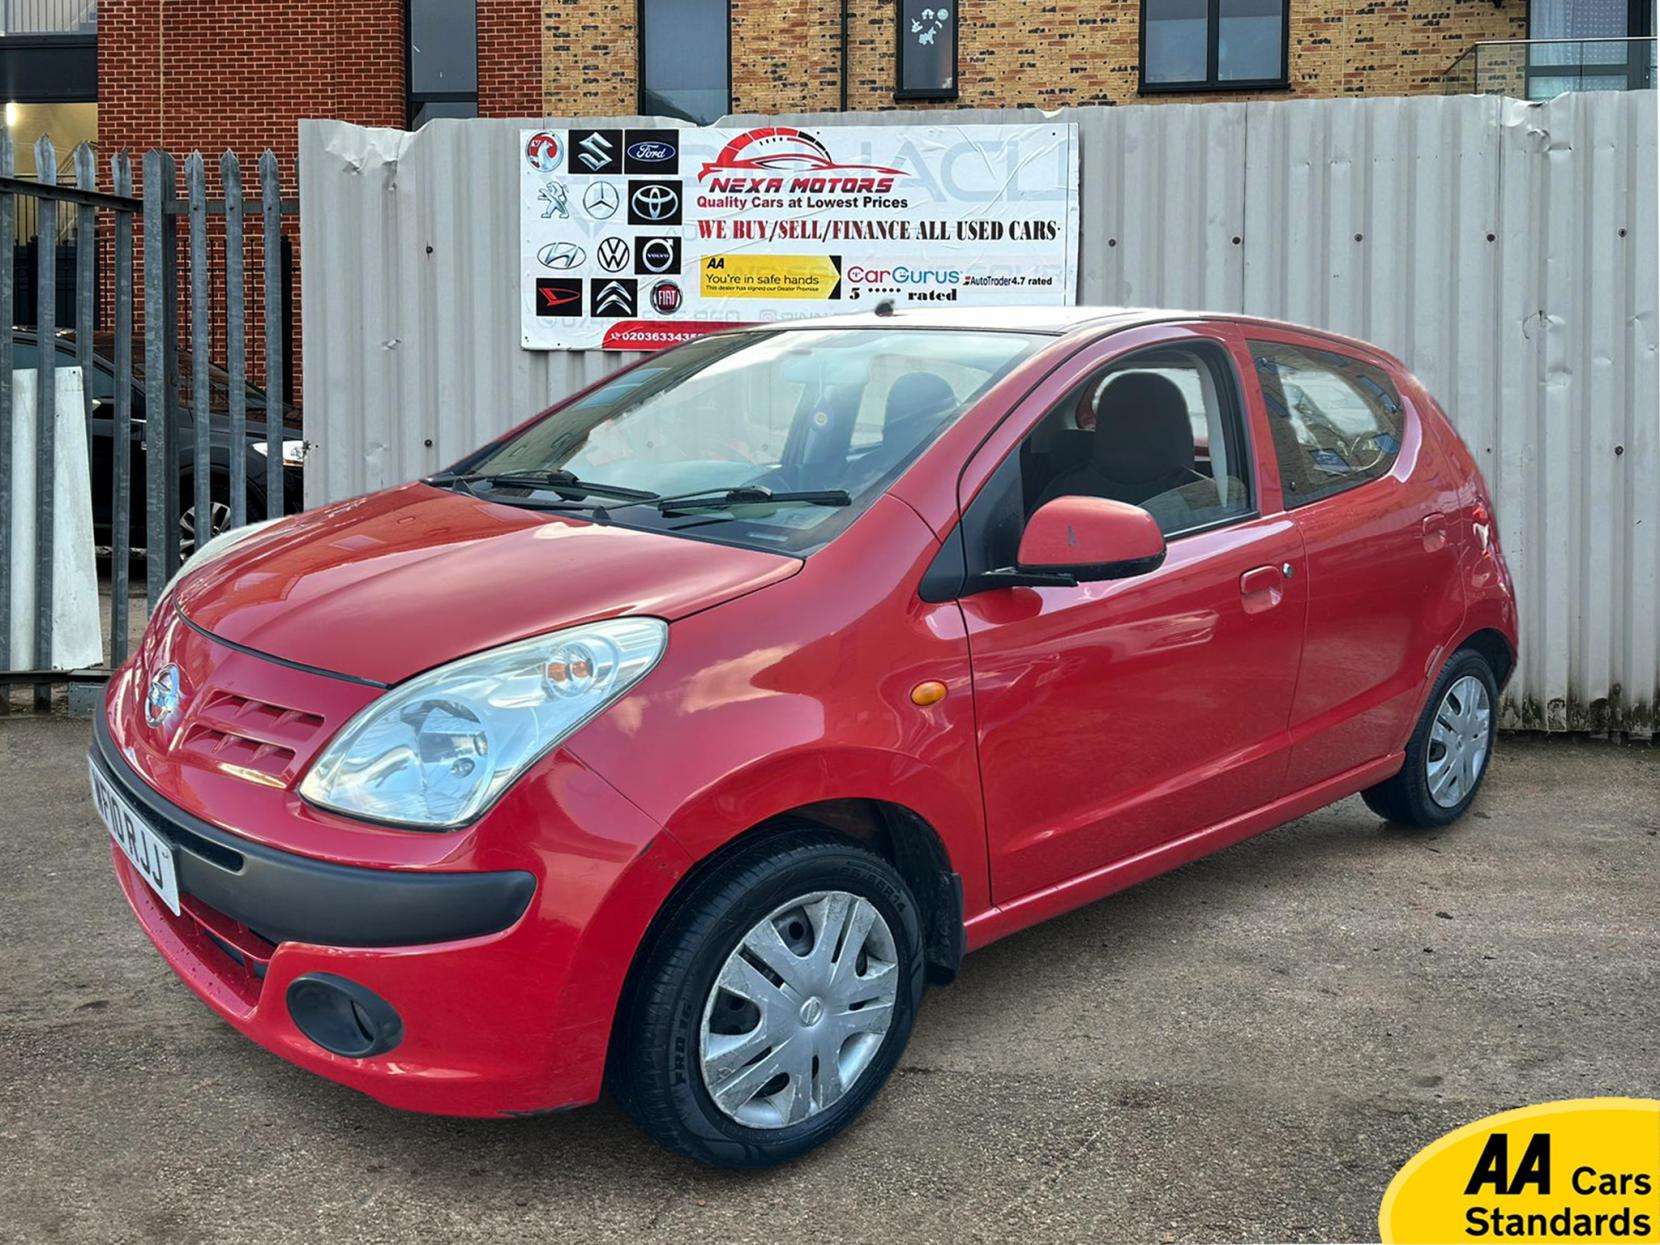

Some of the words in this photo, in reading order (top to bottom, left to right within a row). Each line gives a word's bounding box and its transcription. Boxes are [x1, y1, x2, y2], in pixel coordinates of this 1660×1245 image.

[636, 145, 666, 158] Ford
[709, 178, 783, 193] NEXA
[789, 178, 894, 193] MOTORS
[697, 196, 748, 210] Quality
[751, 196, 784, 208] Cars
[789, 197, 802, 208] at
[807, 196, 859, 208] Lowest
[863, 196, 908, 208] Prices
[697, 220, 727, 240] WE
[733, 220, 911, 242] BUY/SELL/FINANCE
[916, 220, 950, 240] ALL
[957, 220, 1003, 240] USED
[1009, 220, 1057, 240] CARS
[707, 257, 725, 269] AA
[706, 273, 741, 284] You're
[744, 273, 754, 284] in
[757, 273, 781, 284] safe
[784, 274, 819, 285] hands
[847, 266, 960, 284] CarGurus
[1028, 276, 1052, 285] rated
[658, 290, 677, 305] FIAT
[849, 287, 860, 300] 5
[908, 288, 957, 301] rated
